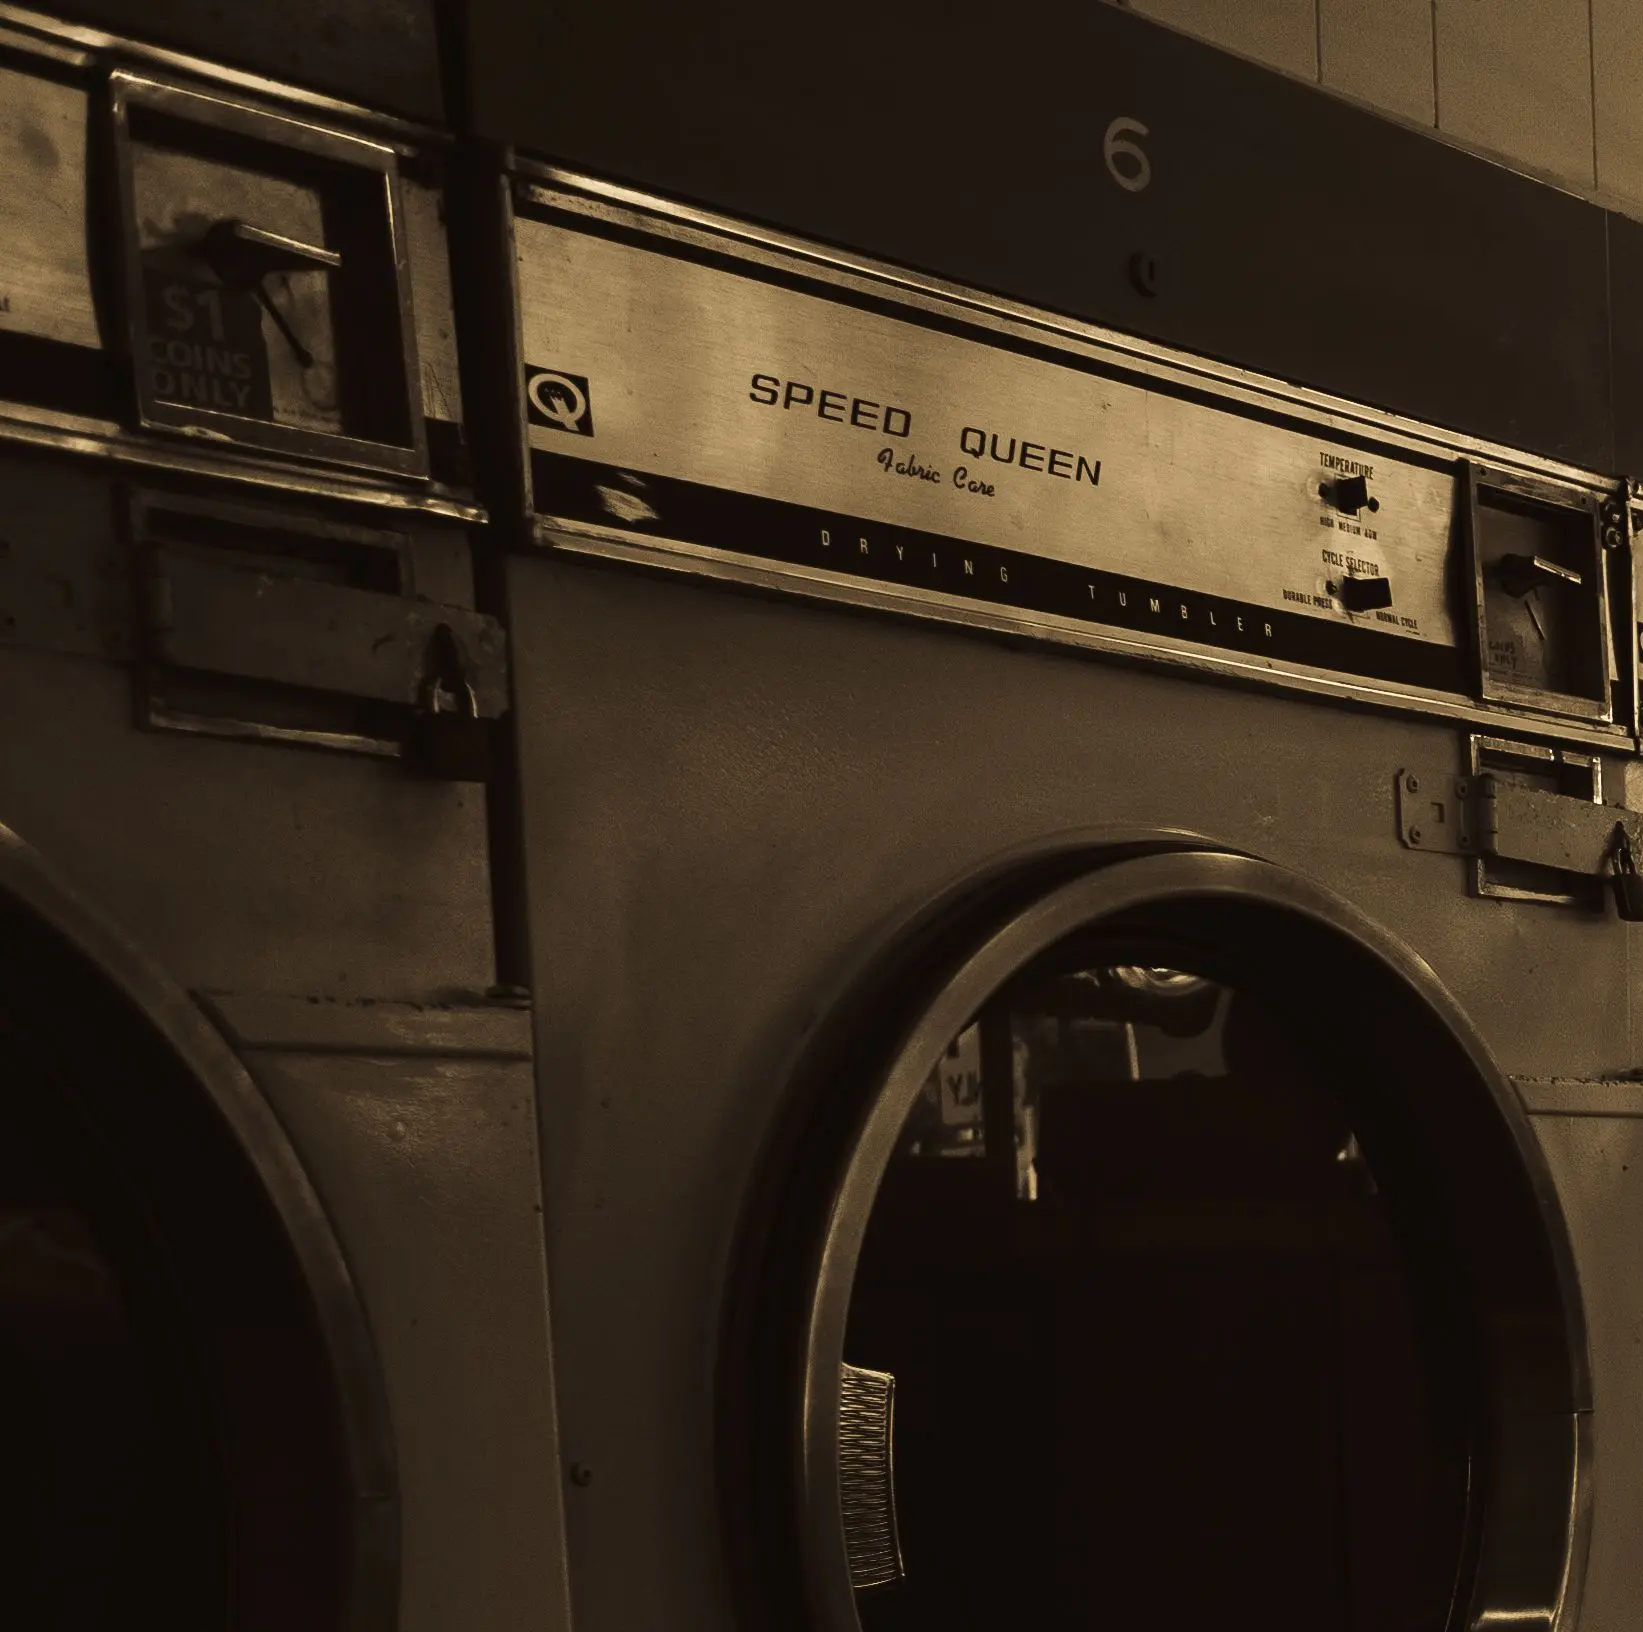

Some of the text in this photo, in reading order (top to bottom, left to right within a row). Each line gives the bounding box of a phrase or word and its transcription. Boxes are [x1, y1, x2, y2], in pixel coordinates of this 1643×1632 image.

[1103, 116, 1152, 193] 6
[162, 282, 225, 342] $1
[150, 338, 252, 380] COINS
[152, 367, 252, 408] ONLY
[749, 373, 1102, 487] SPEED QUEEN
[877, 448, 996, 498] Fabric Care
[1319, 452, 1374, 480] TEMPERATURE
[821, 530, 1273, 638] DRYING TUMBLER
[1322, 549, 1379, 577] CYCLE SELECTOR
